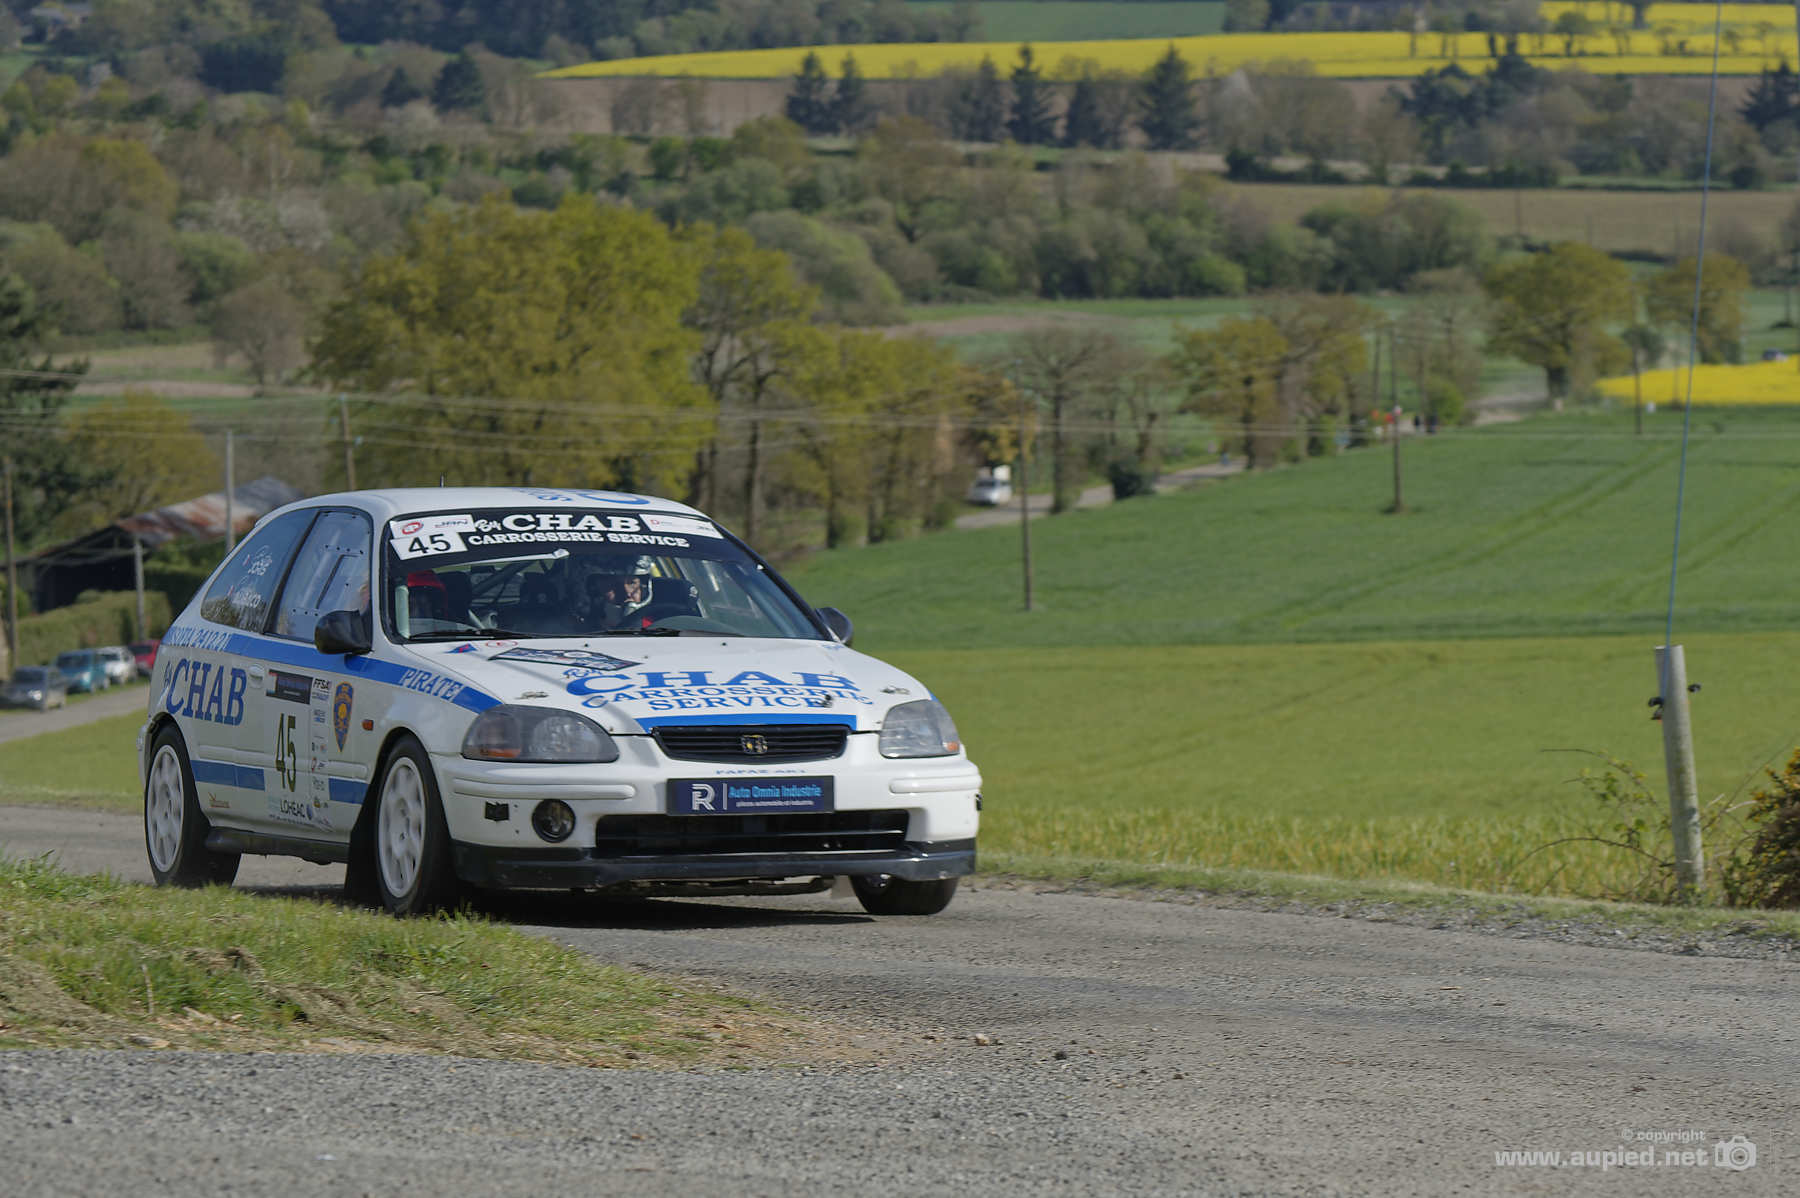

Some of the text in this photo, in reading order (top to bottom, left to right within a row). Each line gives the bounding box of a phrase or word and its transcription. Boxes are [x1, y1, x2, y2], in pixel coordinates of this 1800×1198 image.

[502, 514, 641, 533] CHAB
[408, 533, 452, 554] 45
[468, 532, 690, 548] CARROSSERIE SERVICE
[166, 658, 247, 726] CHAB
[400, 667, 465, 703] PIRATE
[566, 671, 861, 696] CHAB
[581, 687, 873, 708] CARROSSERIE
[648, 696, 829, 711] SERVICE
[275, 713, 297, 793] 45
[728, 783, 824, 798] Auto Omnia Industrie
